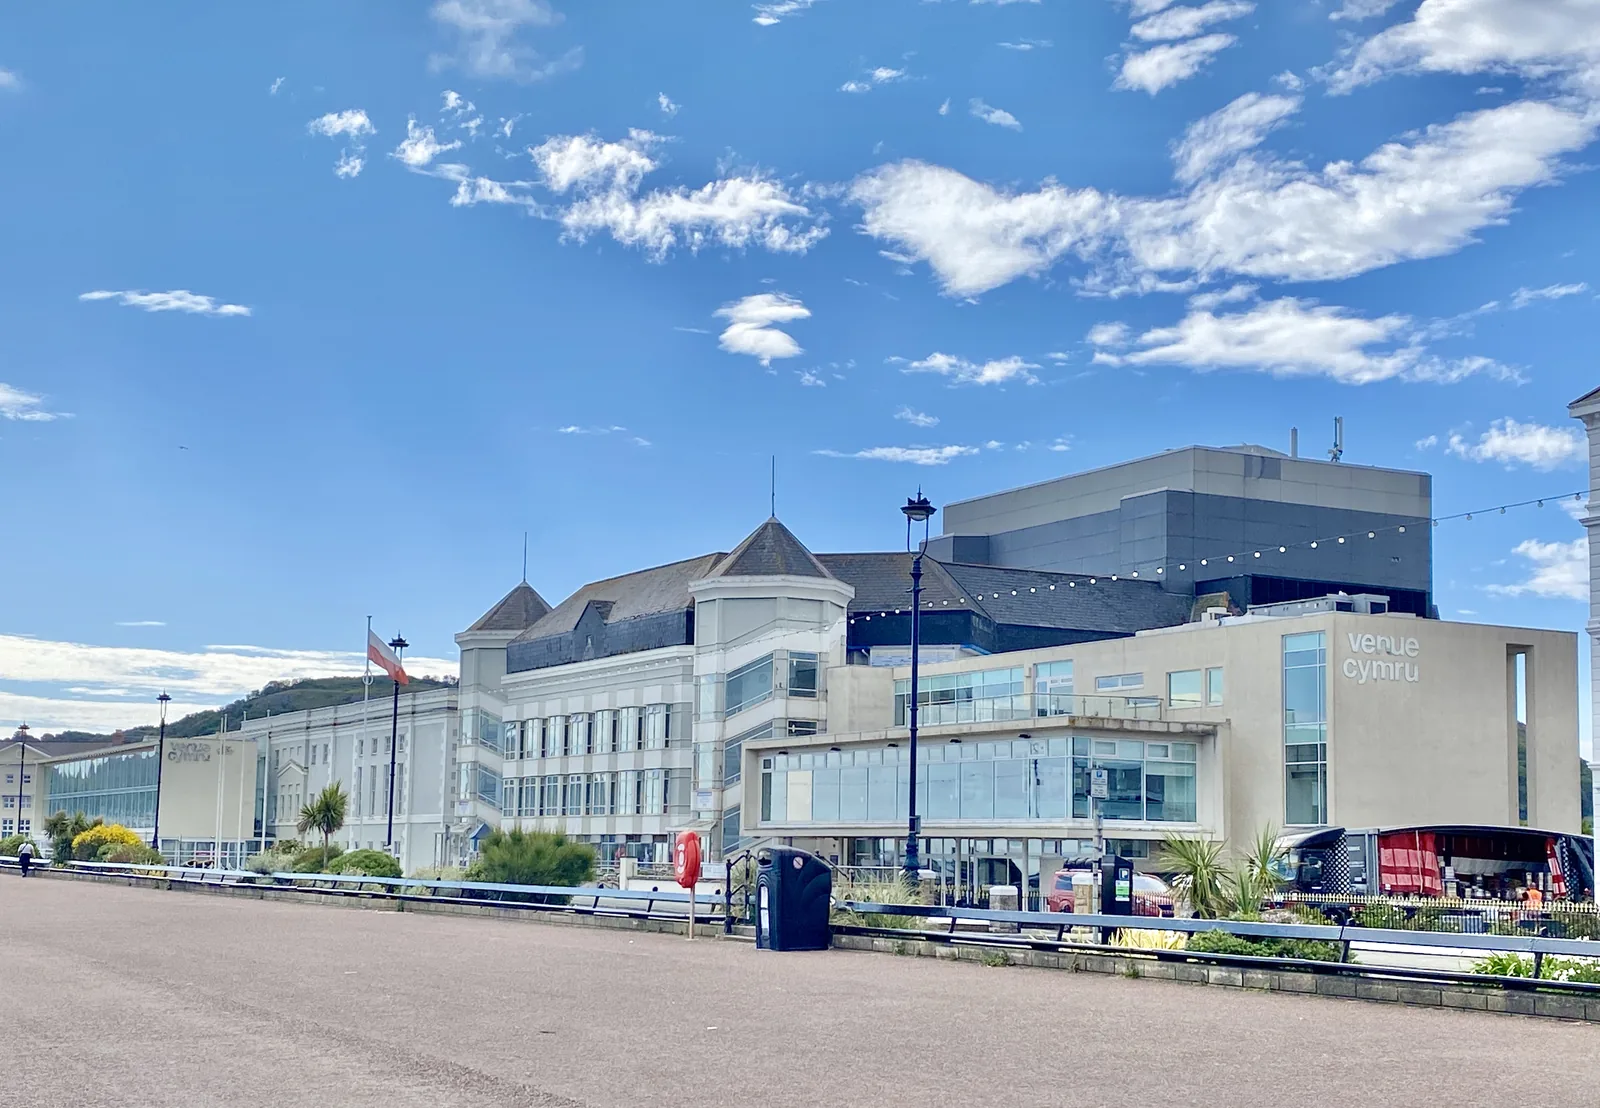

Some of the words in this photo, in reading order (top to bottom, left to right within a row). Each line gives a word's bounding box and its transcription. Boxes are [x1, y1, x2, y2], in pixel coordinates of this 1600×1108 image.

[1347, 632, 1420, 658] venue
[1342, 658, 1420, 685] cymru
[1121, 870, 1129, 879] P
